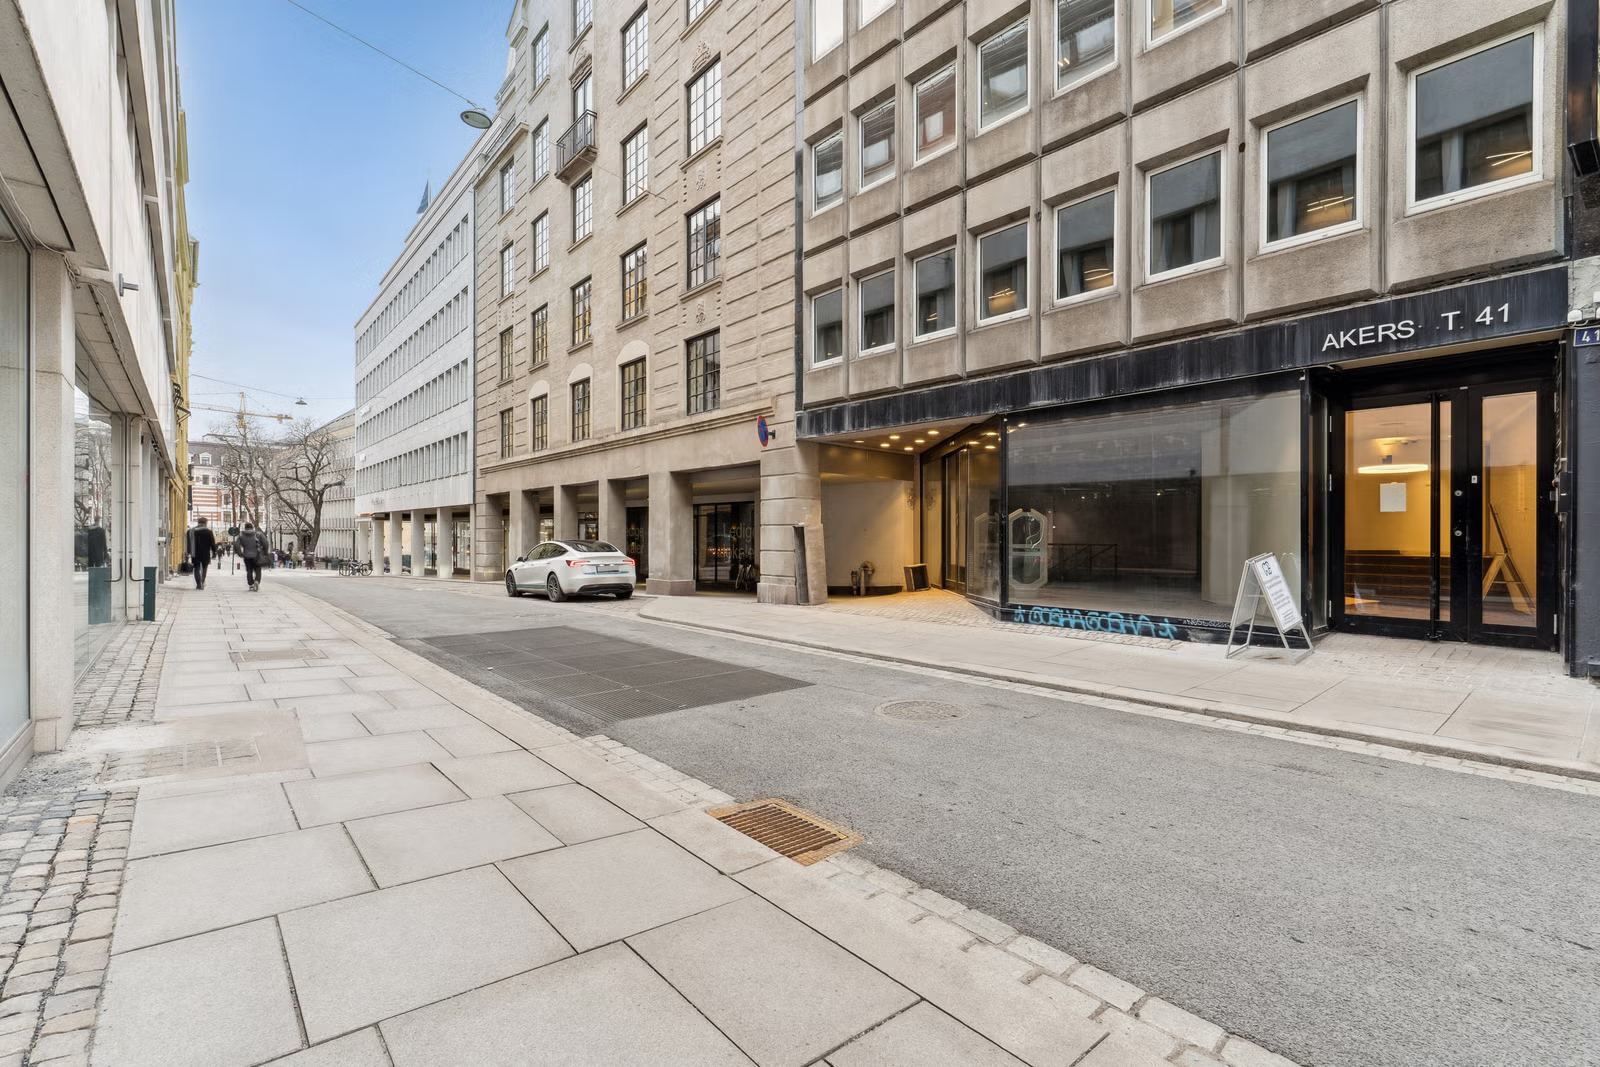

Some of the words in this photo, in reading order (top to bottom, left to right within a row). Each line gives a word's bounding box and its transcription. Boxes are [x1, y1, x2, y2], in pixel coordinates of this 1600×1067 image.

[1322, 320, 1415, 351] AKERS
[1475, 303, 1509, 325] 41
[1582, 329, 1600, 342] 41
